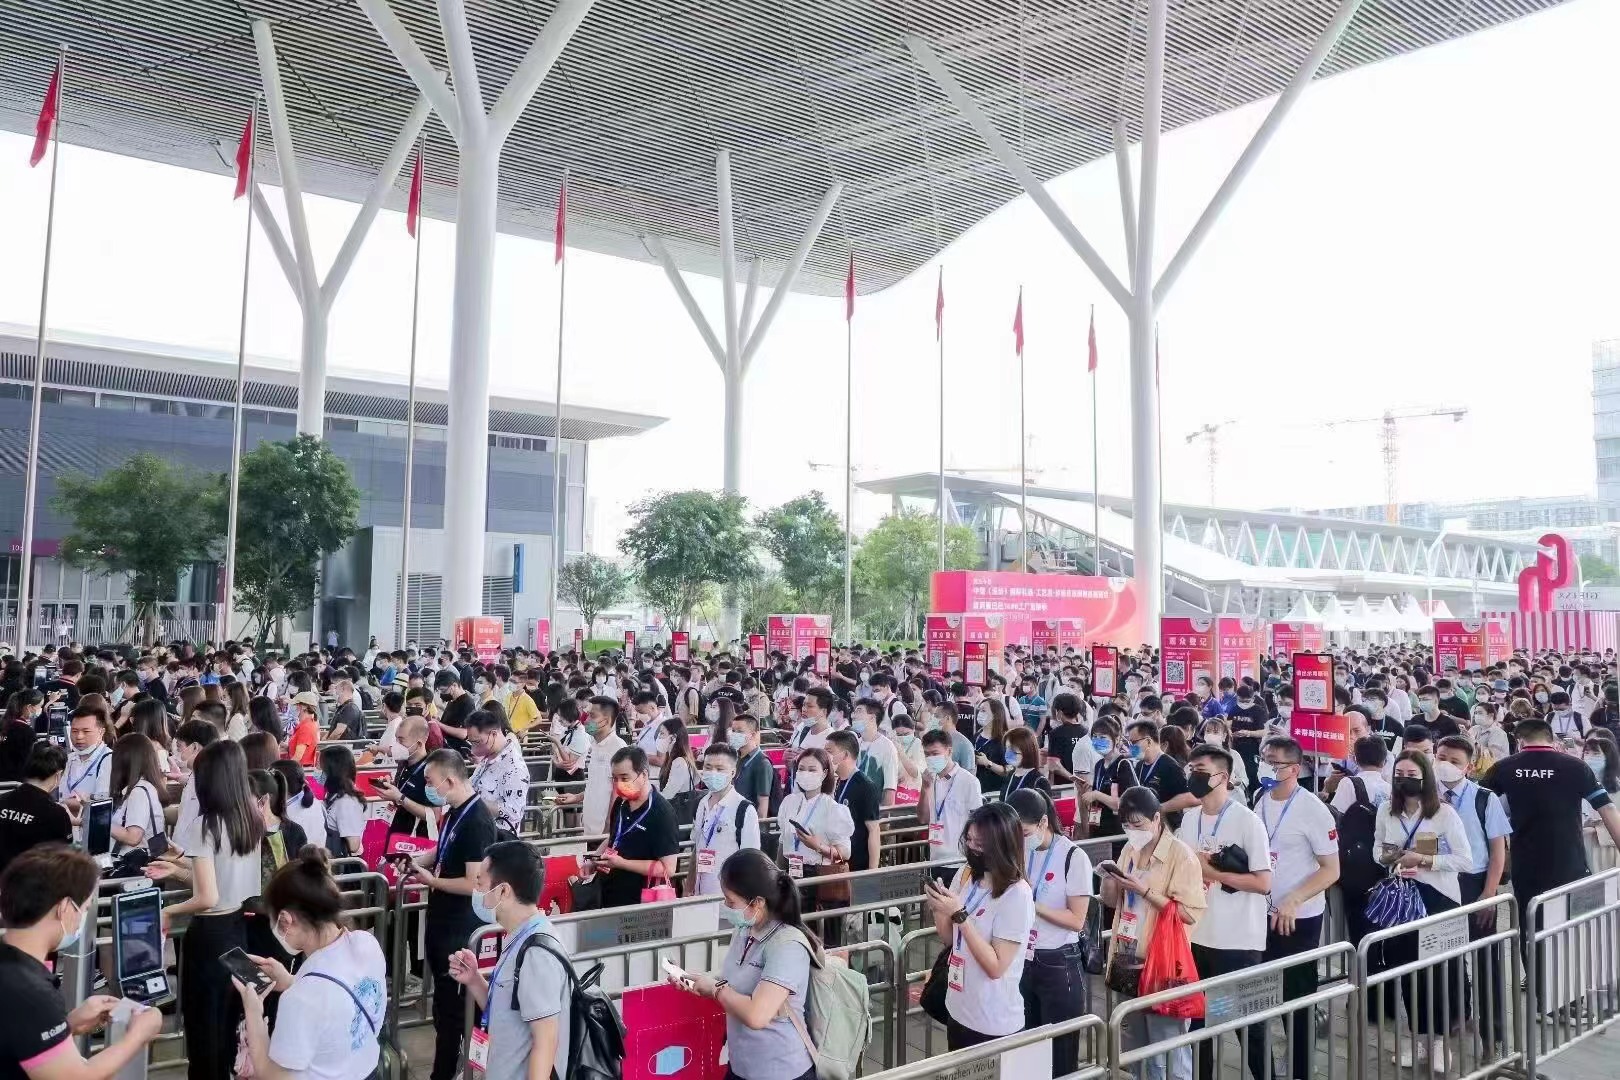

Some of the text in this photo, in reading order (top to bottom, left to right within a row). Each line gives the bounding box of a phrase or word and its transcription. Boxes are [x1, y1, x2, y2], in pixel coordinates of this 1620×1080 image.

[1515, 768, 1555, 779] STAFF
[0, 808, 35, 825] STAFF
[972, 1058, 995, 1073] World
